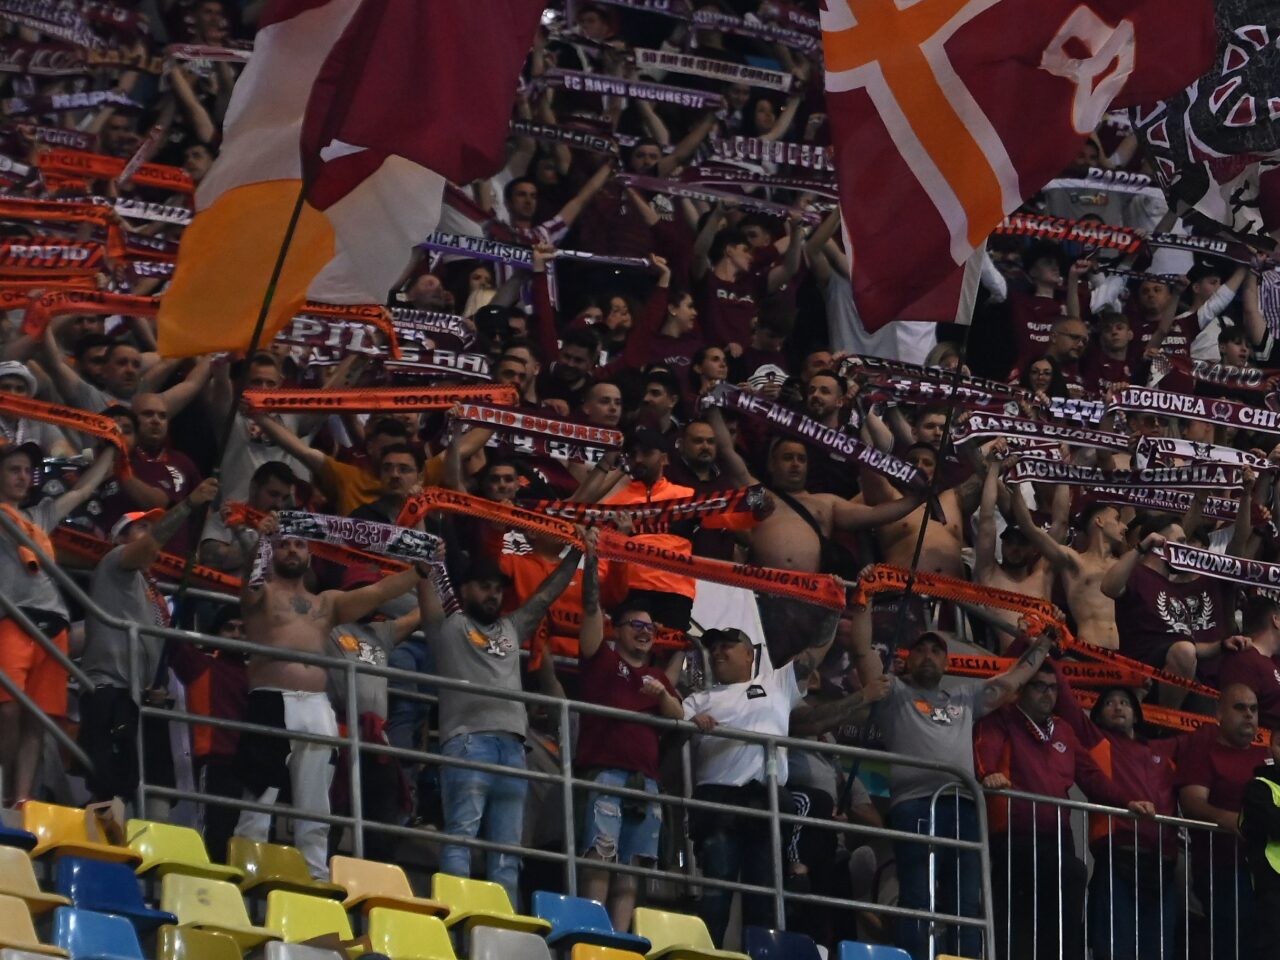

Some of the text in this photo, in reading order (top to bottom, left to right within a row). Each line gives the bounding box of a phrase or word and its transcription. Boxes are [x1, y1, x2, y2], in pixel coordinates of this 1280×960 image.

[564, 76, 582, 89] FC
[584, 77, 626, 95] RAPID
[1071, 225, 1132, 246] RAPID
[10, 243, 92, 263] RAPID
[1192, 359, 1266, 387] RAPID
[737, 392, 792, 427] NE-AM
[1122, 390, 1207, 421] LEGIUNEA
[48, 407, 122, 434] HOOLIGA
[968, 416, 1130, 448] RAPID BUCURE
[1235, 451, 1267, 467] 192
[1016, 462, 1227, 485] LEGIUNEA CHITILA
[407, 491, 473, 516] OFFICIAL
[327, 518, 381, 545] 1923
[624, 538, 820, 592] OFFICIAL HOOLIGANS
[1169, 546, 1242, 577] LEGIUNEA
[950, 656, 1001, 672] FICIAL
[1061, 665, 1123, 680] OLIGANS
